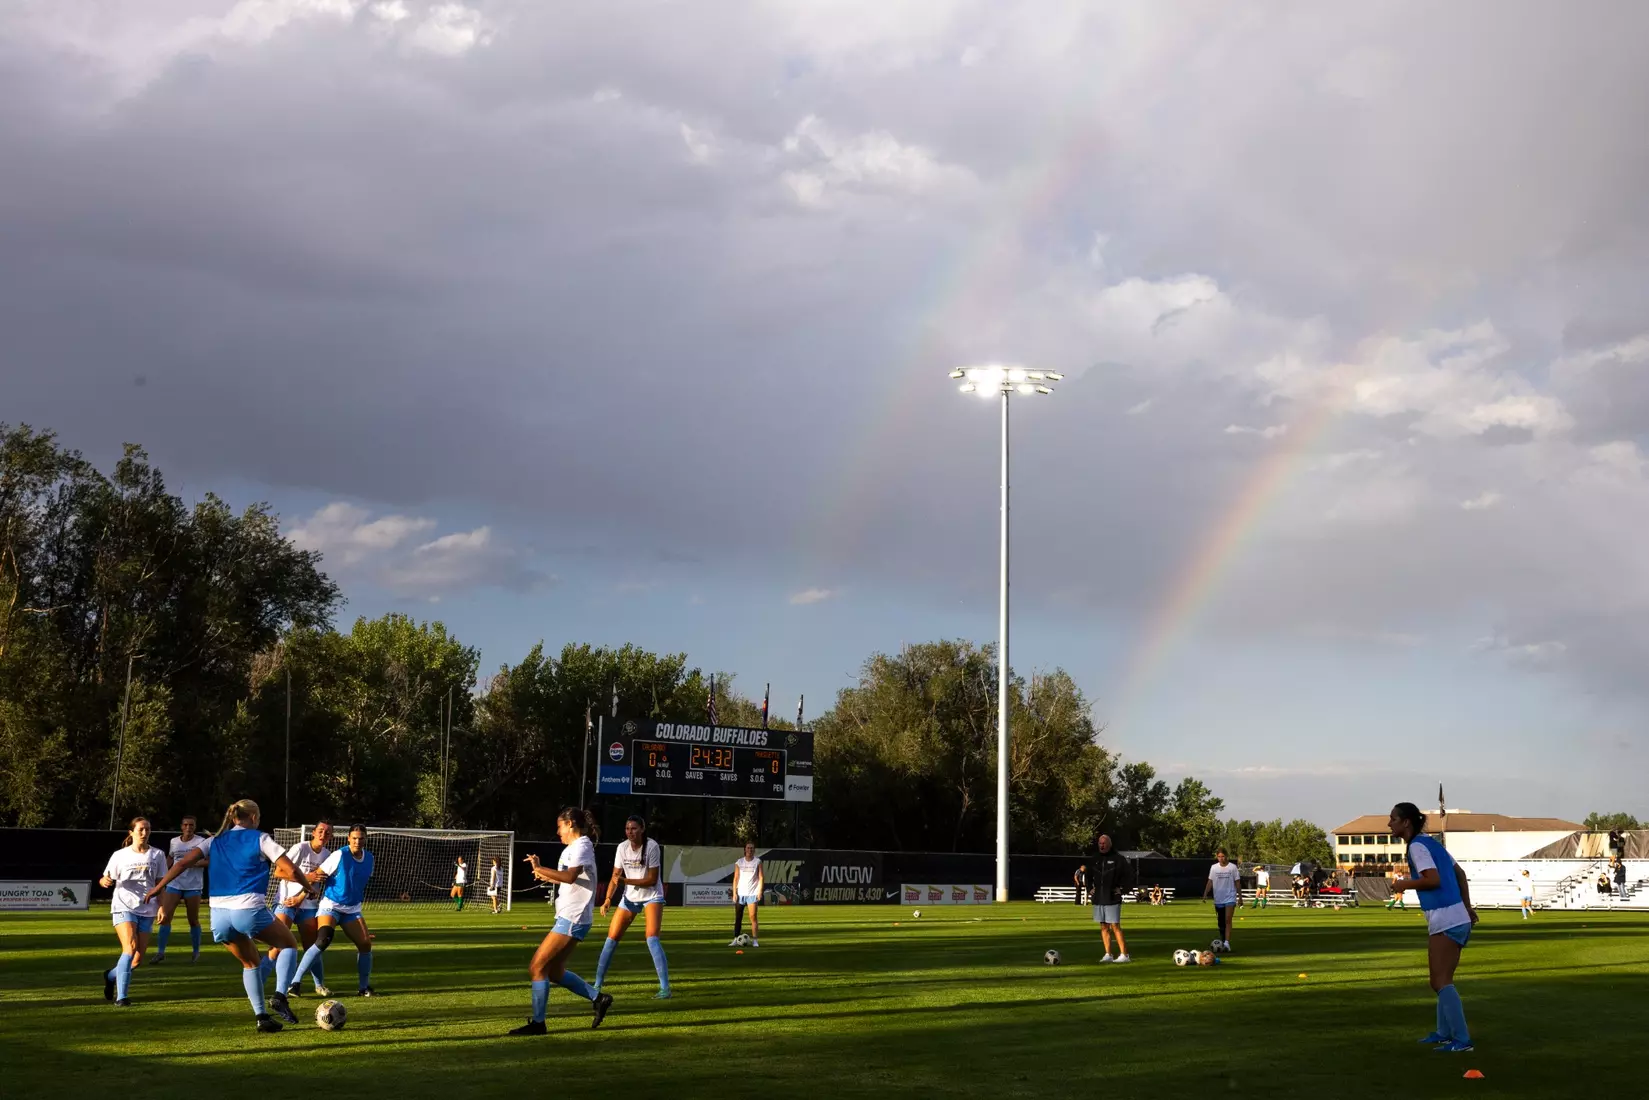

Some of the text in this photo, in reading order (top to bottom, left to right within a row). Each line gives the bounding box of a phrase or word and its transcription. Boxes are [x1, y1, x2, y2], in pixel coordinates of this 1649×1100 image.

[655, 723, 768, 746] COLORADO BUFFALOES
[649, 752, 656, 767] 0
[692, 748, 732, 767] 24:32
[655, 769, 673, 778] S.O.G.
[772, 760, 779, 774] 0
[634, 778, 646, 786] PEN
[685, 771, 704, 780] SAVES
[720, 773, 738, 781] SAVES
[750, 775, 765, 783] S.O.G.
[773, 784, 784, 792] PEN
[762, 860, 802, 883] NIKE
[821, 865, 873, 884] ARROW
[814, 888, 884, 902] ELEVATION 5,430'
